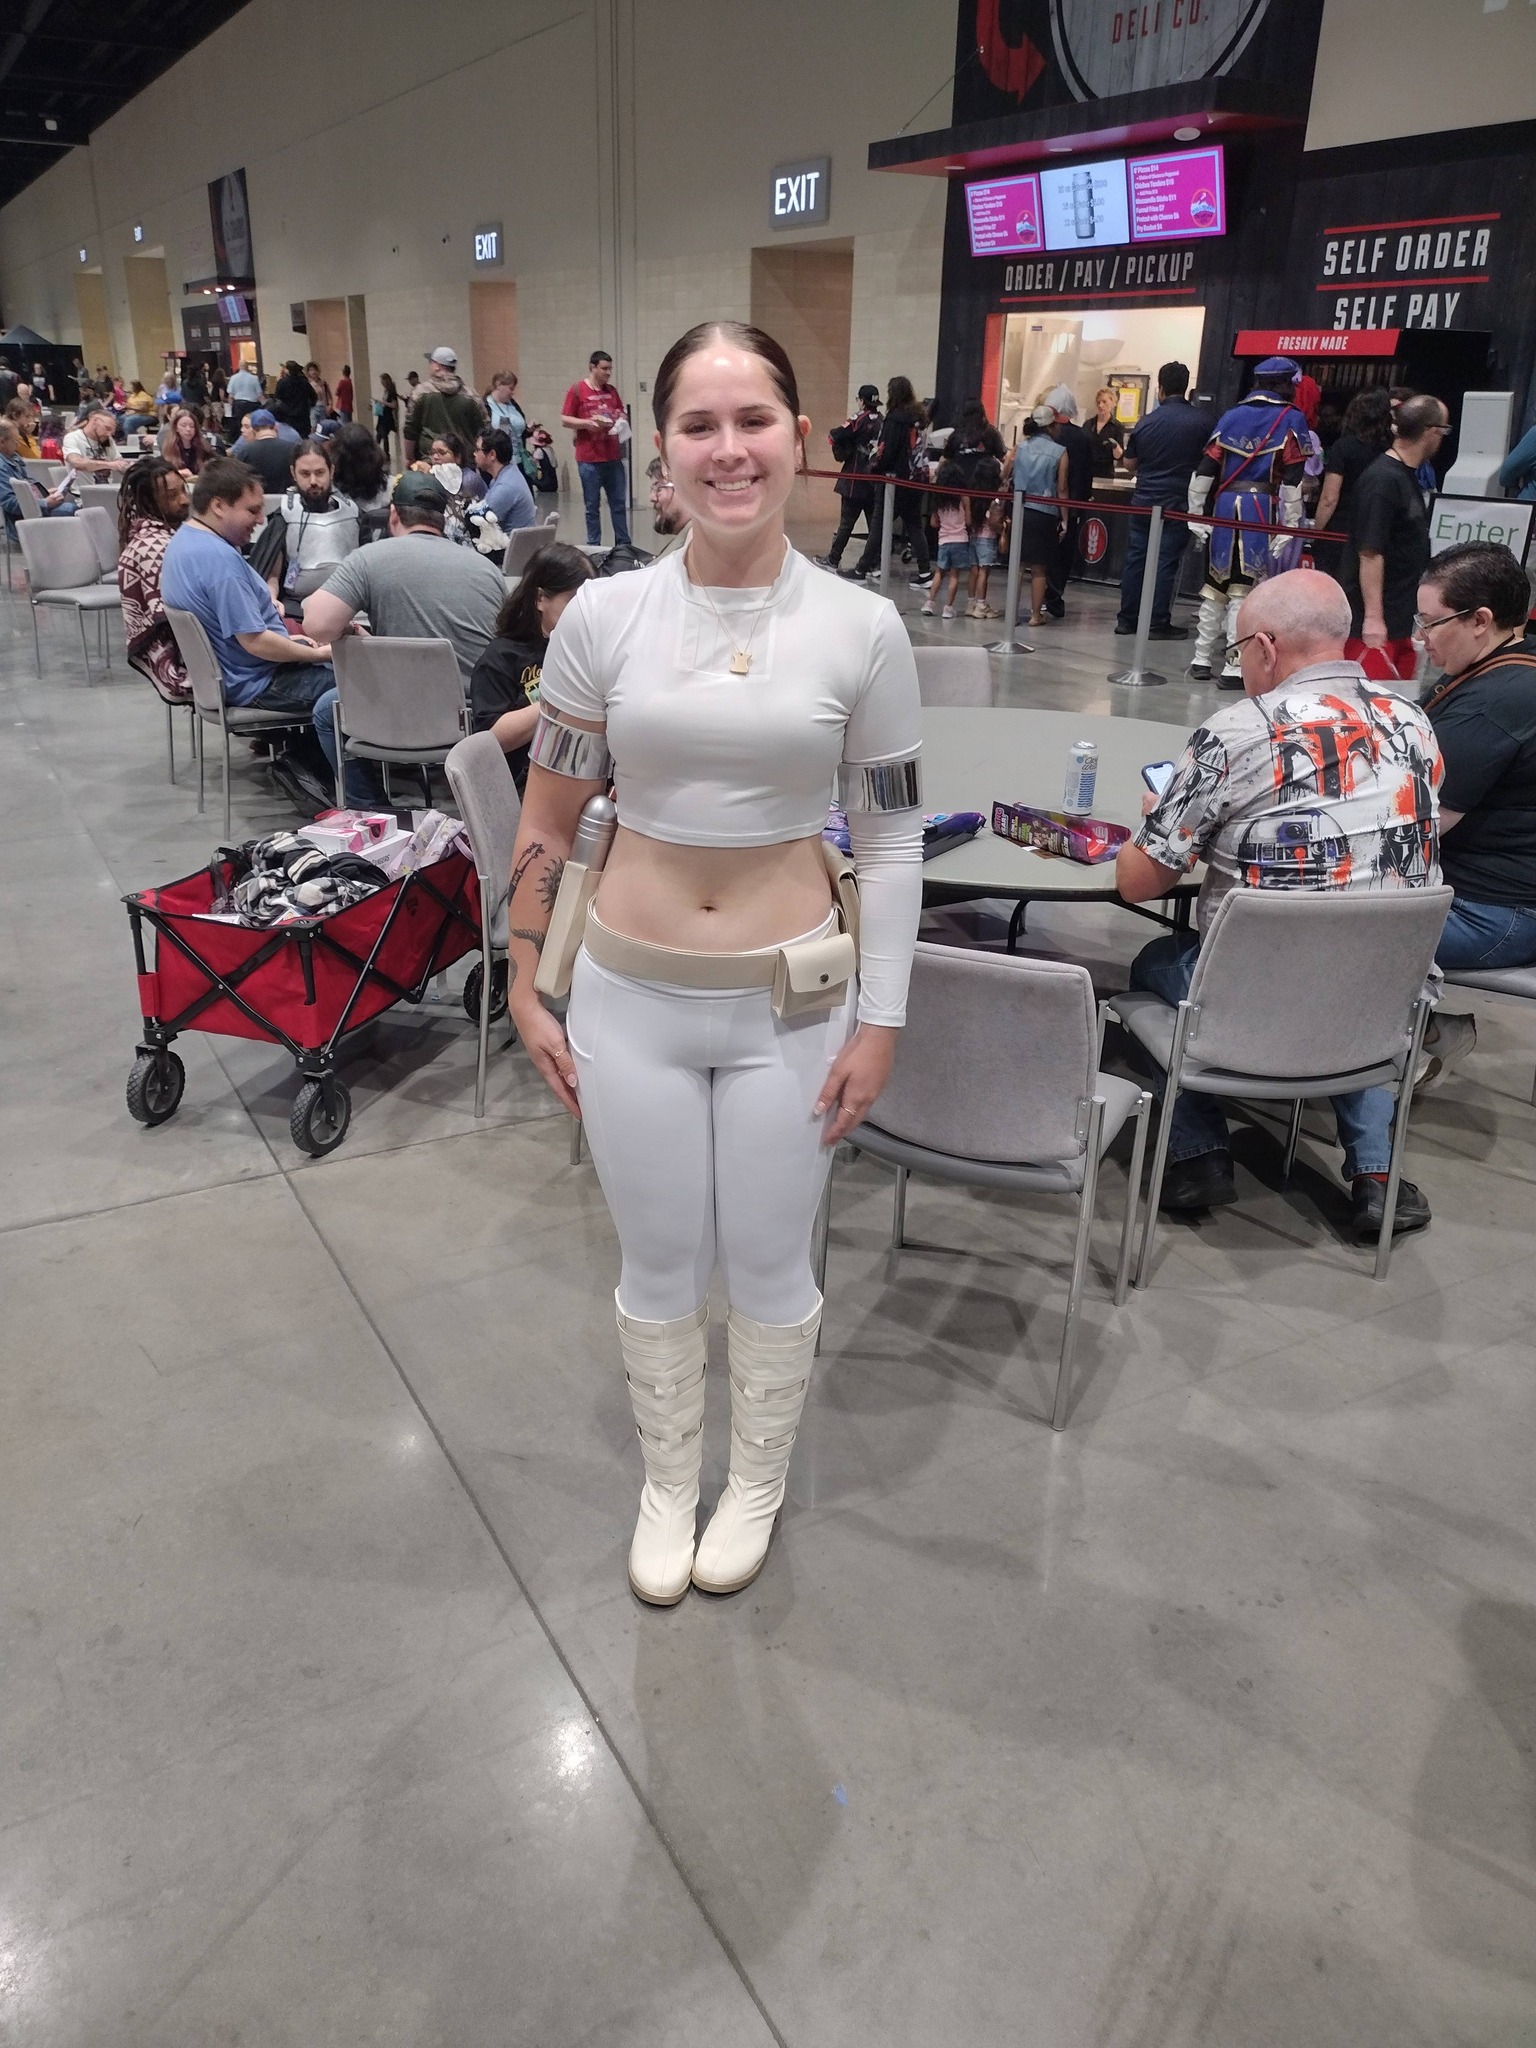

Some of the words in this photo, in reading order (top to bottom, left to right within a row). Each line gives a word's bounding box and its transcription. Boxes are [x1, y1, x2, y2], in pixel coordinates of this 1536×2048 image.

[1112, 1, 1160, 44] DELI
[1173, 0, 1209, 29] CO.
[774, 172, 820, 215] EXIT
[475, 232, 497, 260] EXIT
[1323, 237, 1387, 276] SELF
[1395, 229, 1491, 272] ORDER
[1005, 263, 1054, 292] ORDER
[1073, 259, 1105, 288] PAY
[1125, 252, 1194, 285] PICKUP
[1333, 295, 1397, 331] SELF
[1405, 292, 1461, 329] PAY
[1277, 336, 1318, 350] FRESHLY
[1320, 336, 1349, 350] MADE
[1436, 514, 1519, 546] Enter
